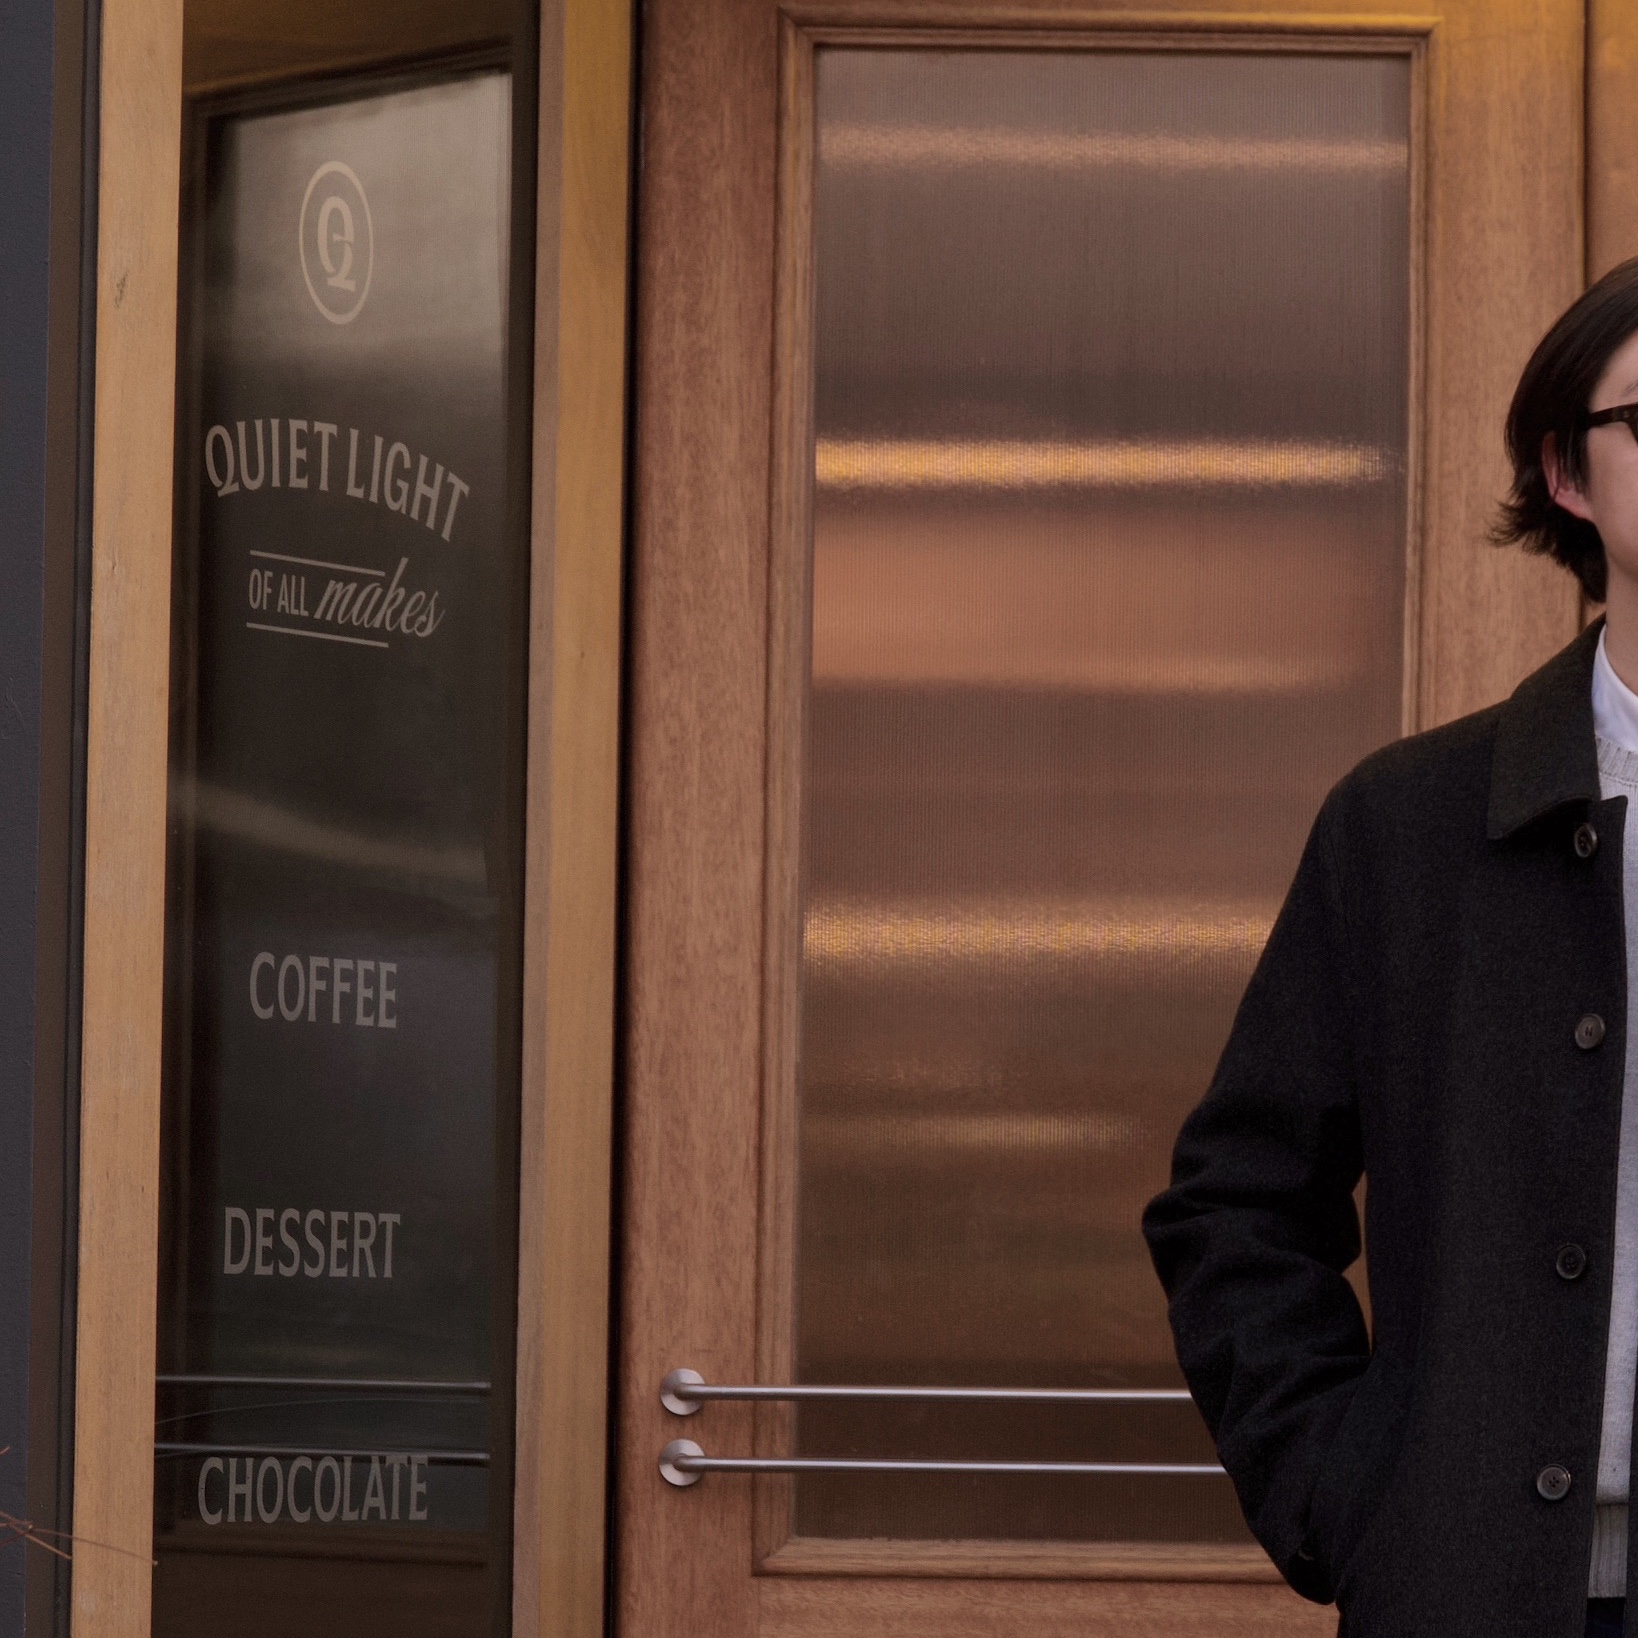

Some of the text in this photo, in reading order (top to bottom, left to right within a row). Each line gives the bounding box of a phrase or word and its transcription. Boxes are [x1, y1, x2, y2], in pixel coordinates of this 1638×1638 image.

[205, 417, 470, 542] QUIET LIGHT
[250, 557, 446, 638] OF ALL makes
[250, 950, 398, 1030] COFFEE
[223, 1206, 401, 1279] DESSERT
[198, 1454, 429, 1526] CHOCOLATE
